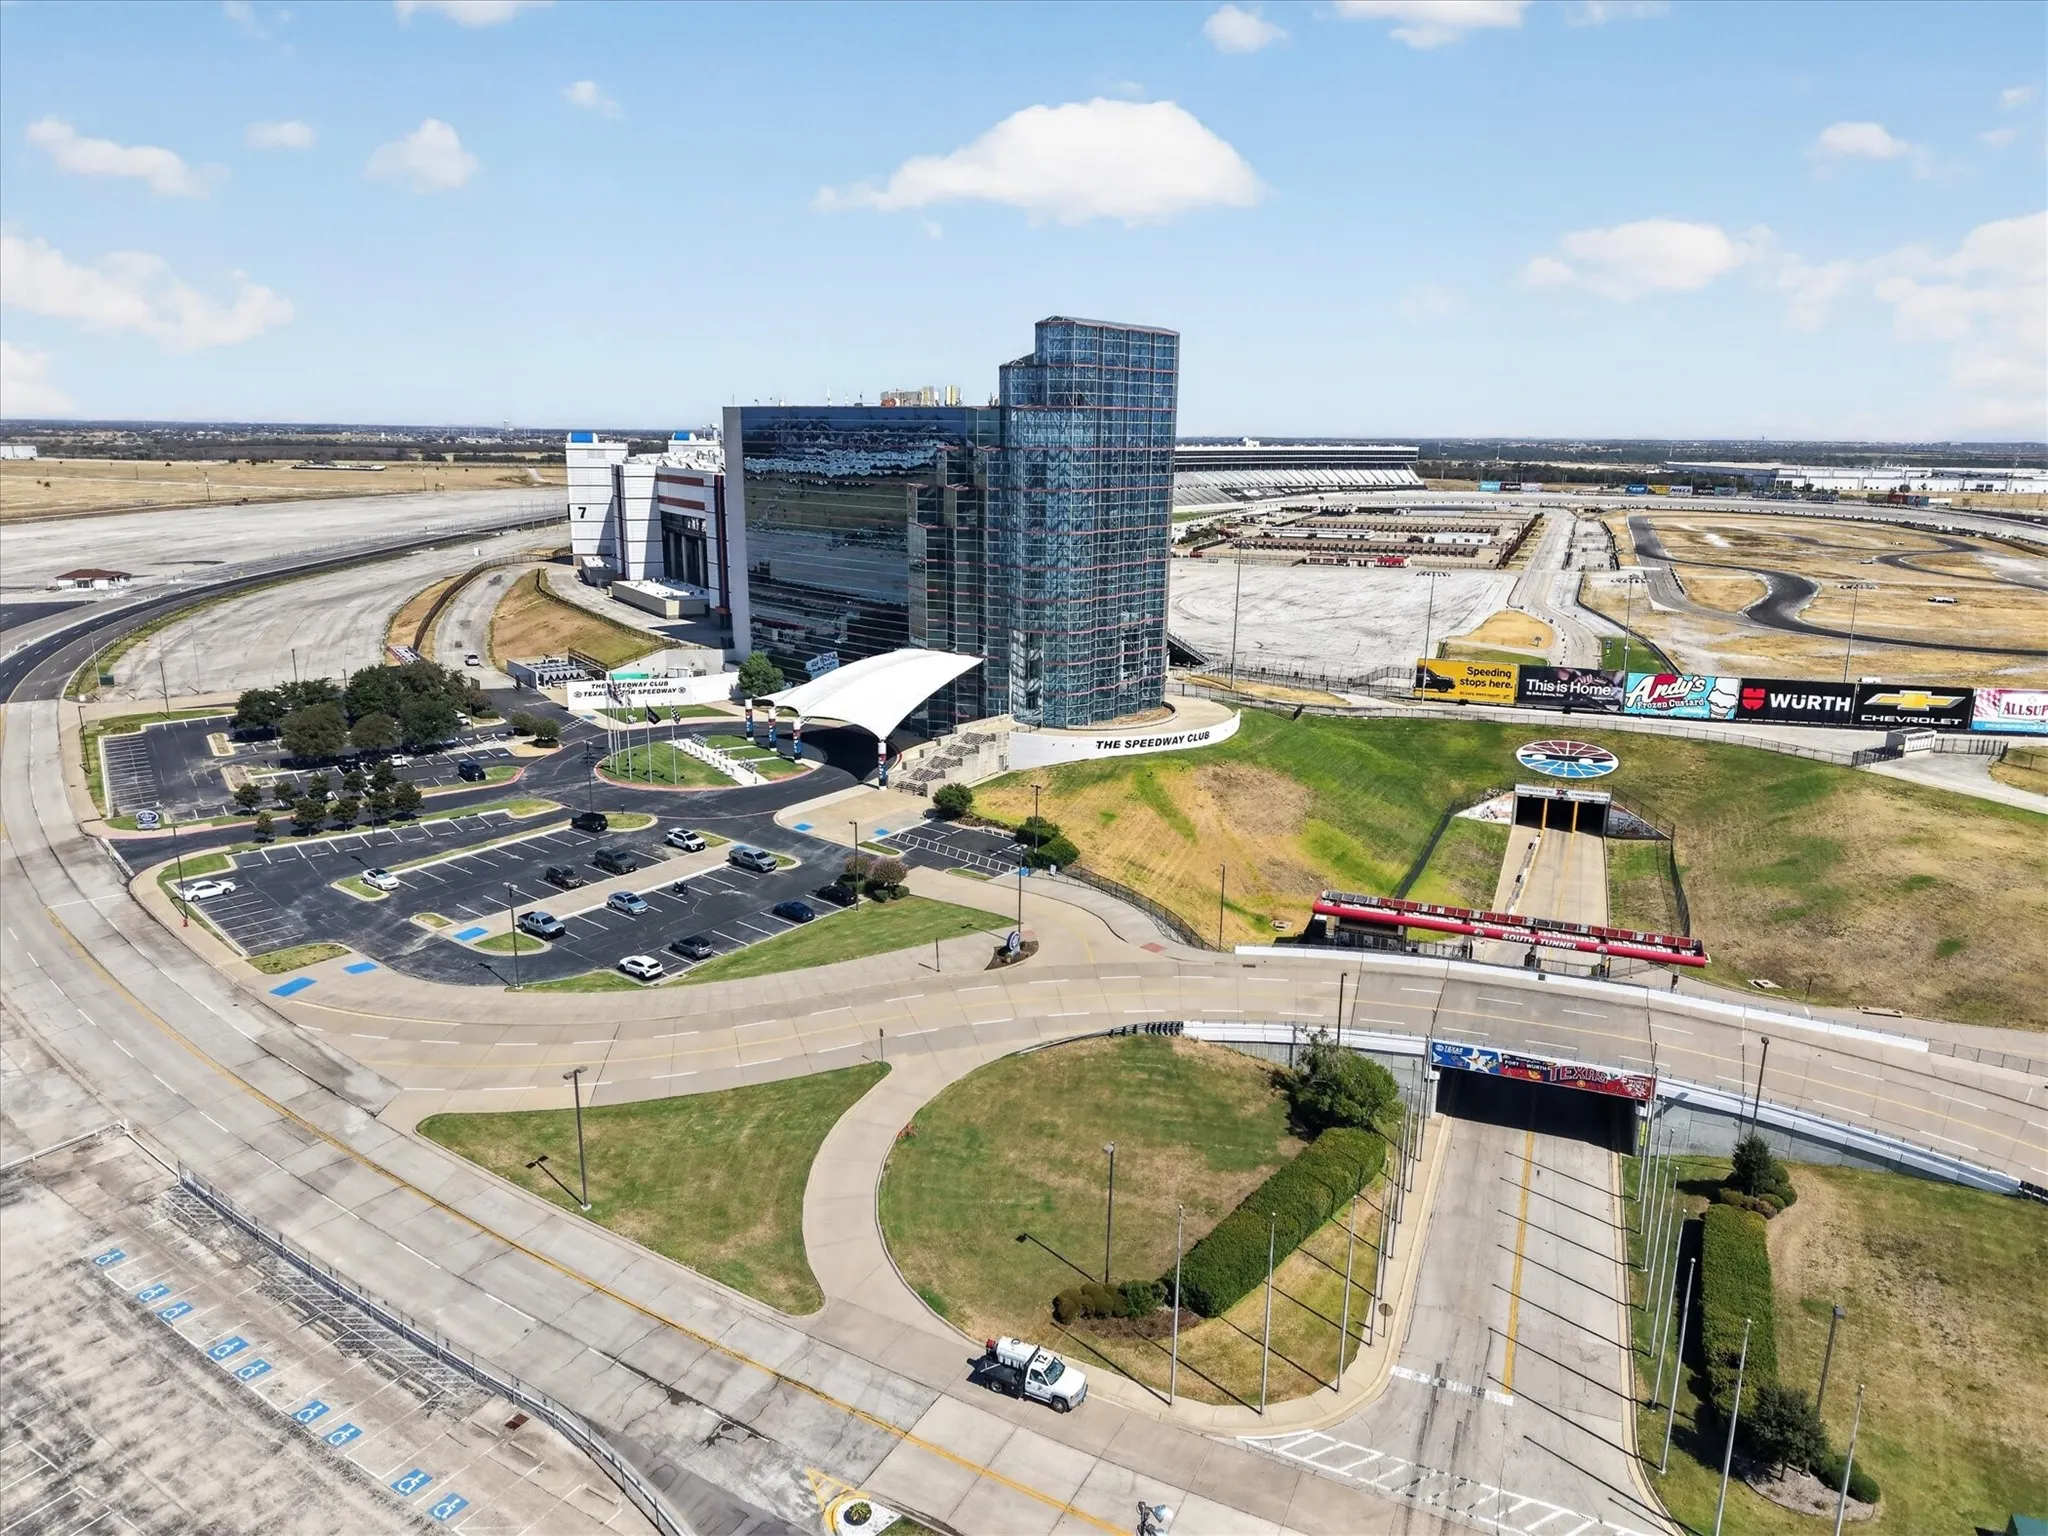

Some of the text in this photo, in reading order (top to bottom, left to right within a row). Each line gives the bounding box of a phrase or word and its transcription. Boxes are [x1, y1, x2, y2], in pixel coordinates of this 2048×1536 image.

[578, 507, 587, 519] 7
[1467, 667, 1512, 679] Speeding
[1460, 678, 1513, 689] stops here.
[1526, 679, 1555, 692] This
[1556, 681, 1568, 692] is
[1570, 682, 1614, 696] Home.
[1625, 675, 1706, 708] Andy's
[1637, 698, 1704, 709] Frozen Custard
[1770, 693, 1851, 712] WÜRTH
[1861, 714, 1962, 725] CHEVROLET
[1096, 731, 1210, 749] THE SPEEDWAY CLUB
[1502, 933, 1578, 950] SOUTH TUNNEL
[1550, 1065, 1609, 1084] TEXAS
